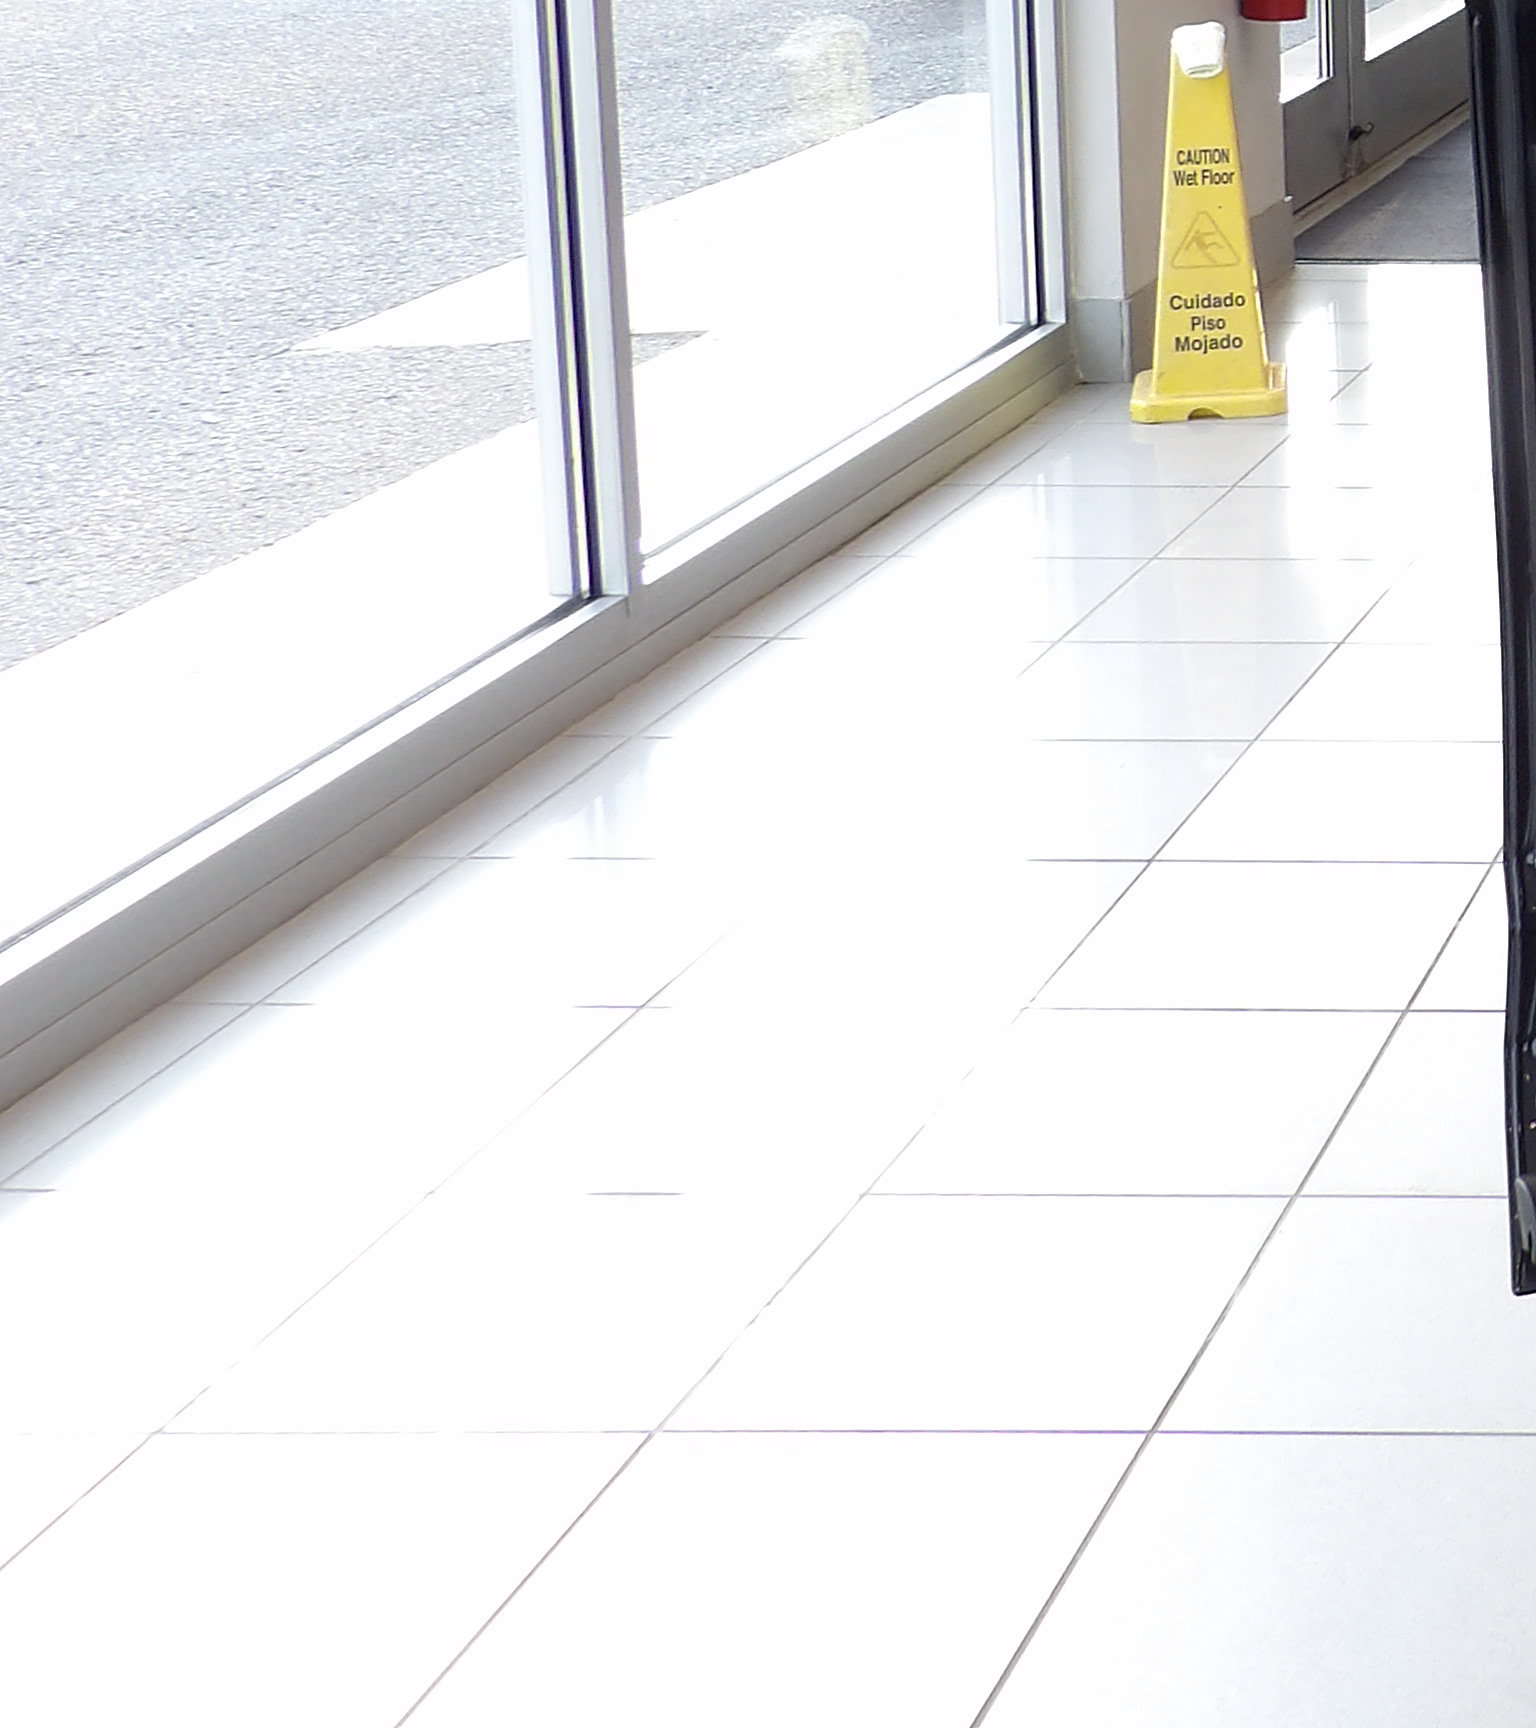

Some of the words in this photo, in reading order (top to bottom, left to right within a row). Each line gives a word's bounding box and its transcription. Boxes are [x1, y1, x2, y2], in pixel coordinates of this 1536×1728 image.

[1176, 148, 1230, 165] CAUTION
[1173, 170, 1198, 186] Wet
[1201, 169, 1235, 186] Floor
[1169, 292, 1246, 310] Cuidado
[1190, 316, 1226, 331] Piso
[1174, 334, 1244, 354] Mojado
